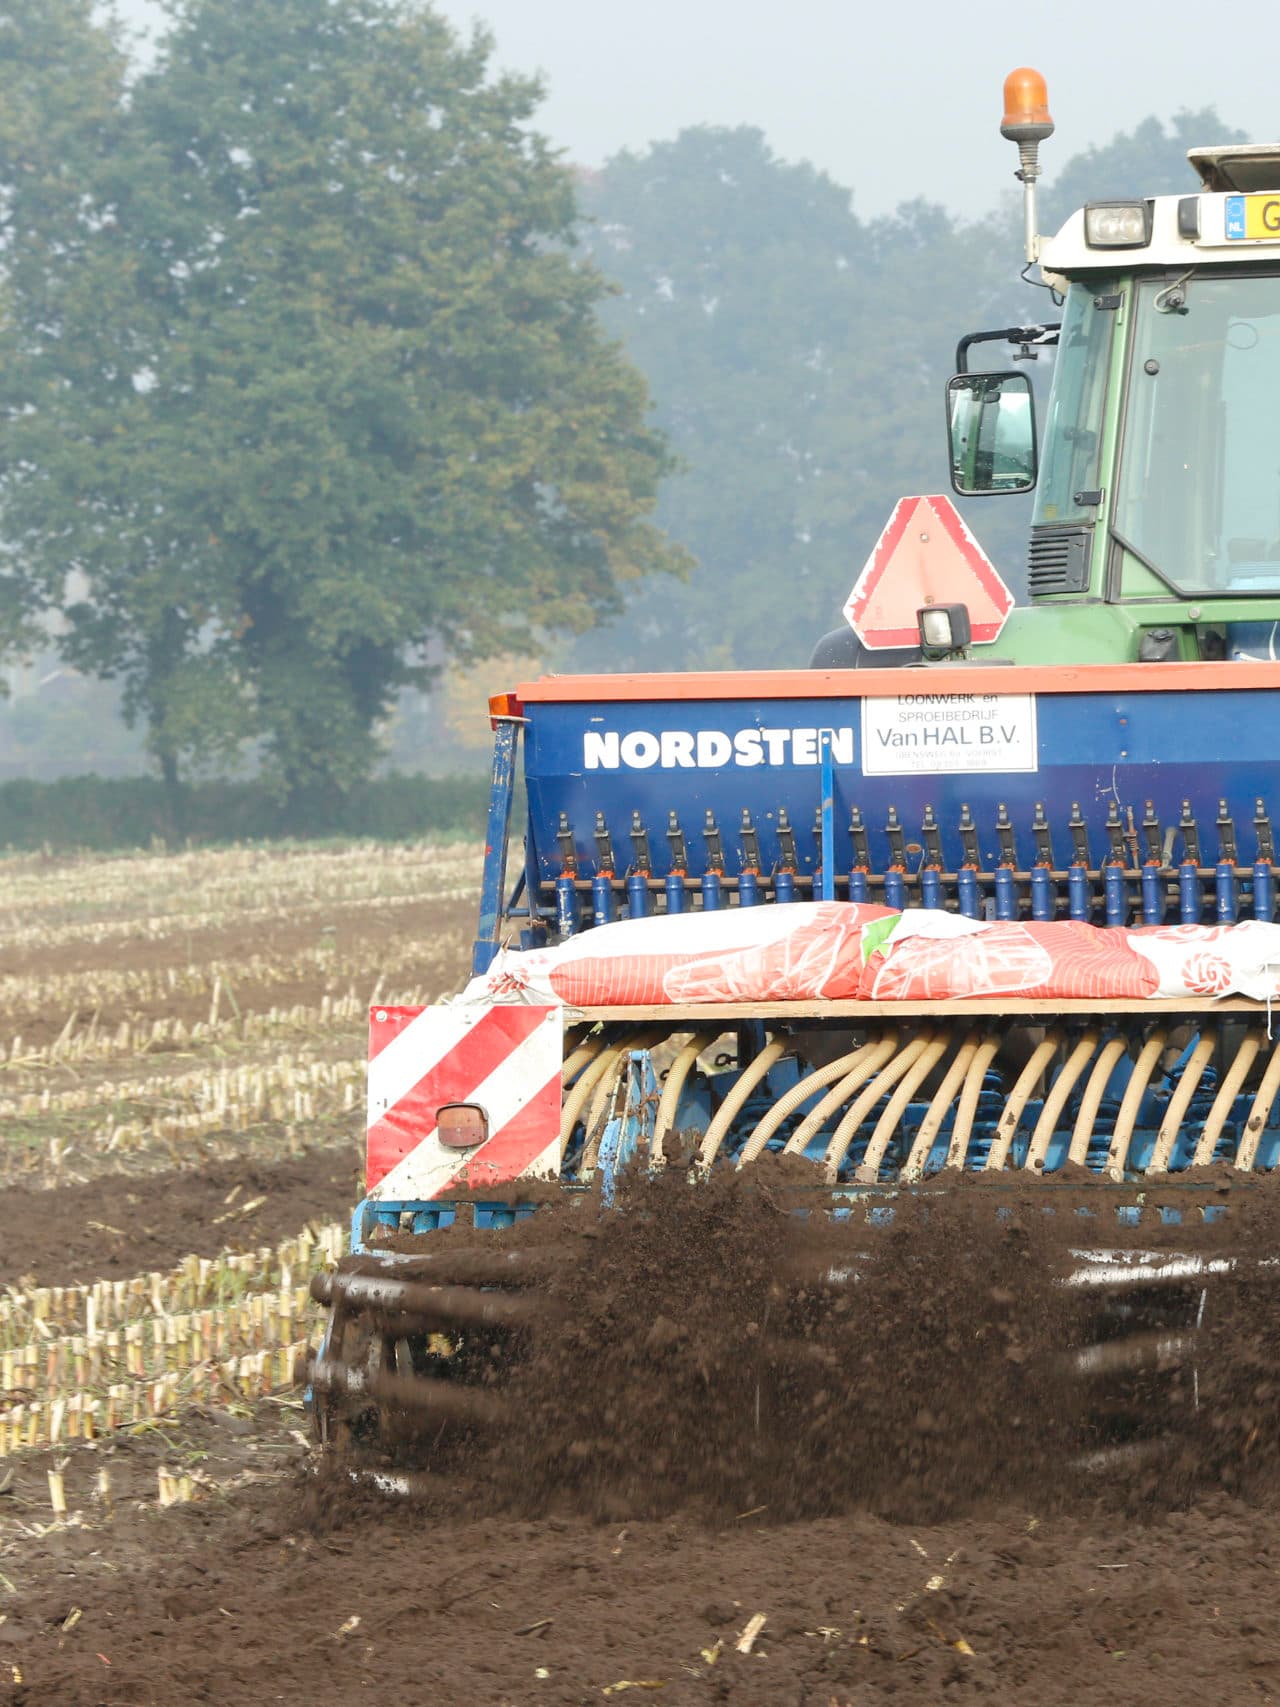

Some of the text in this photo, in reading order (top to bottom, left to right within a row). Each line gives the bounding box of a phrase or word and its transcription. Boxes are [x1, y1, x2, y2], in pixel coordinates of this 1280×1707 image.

[1228, 222, 1243, 232] NL
[898, 709, 999, 723] SPROEIBEDRIJF
[876, 725, 1021, 747] Van HAL B.V.
[584, 728, 854, 769] NORDSTEN
[1198, 963, 1217, 983] LG
